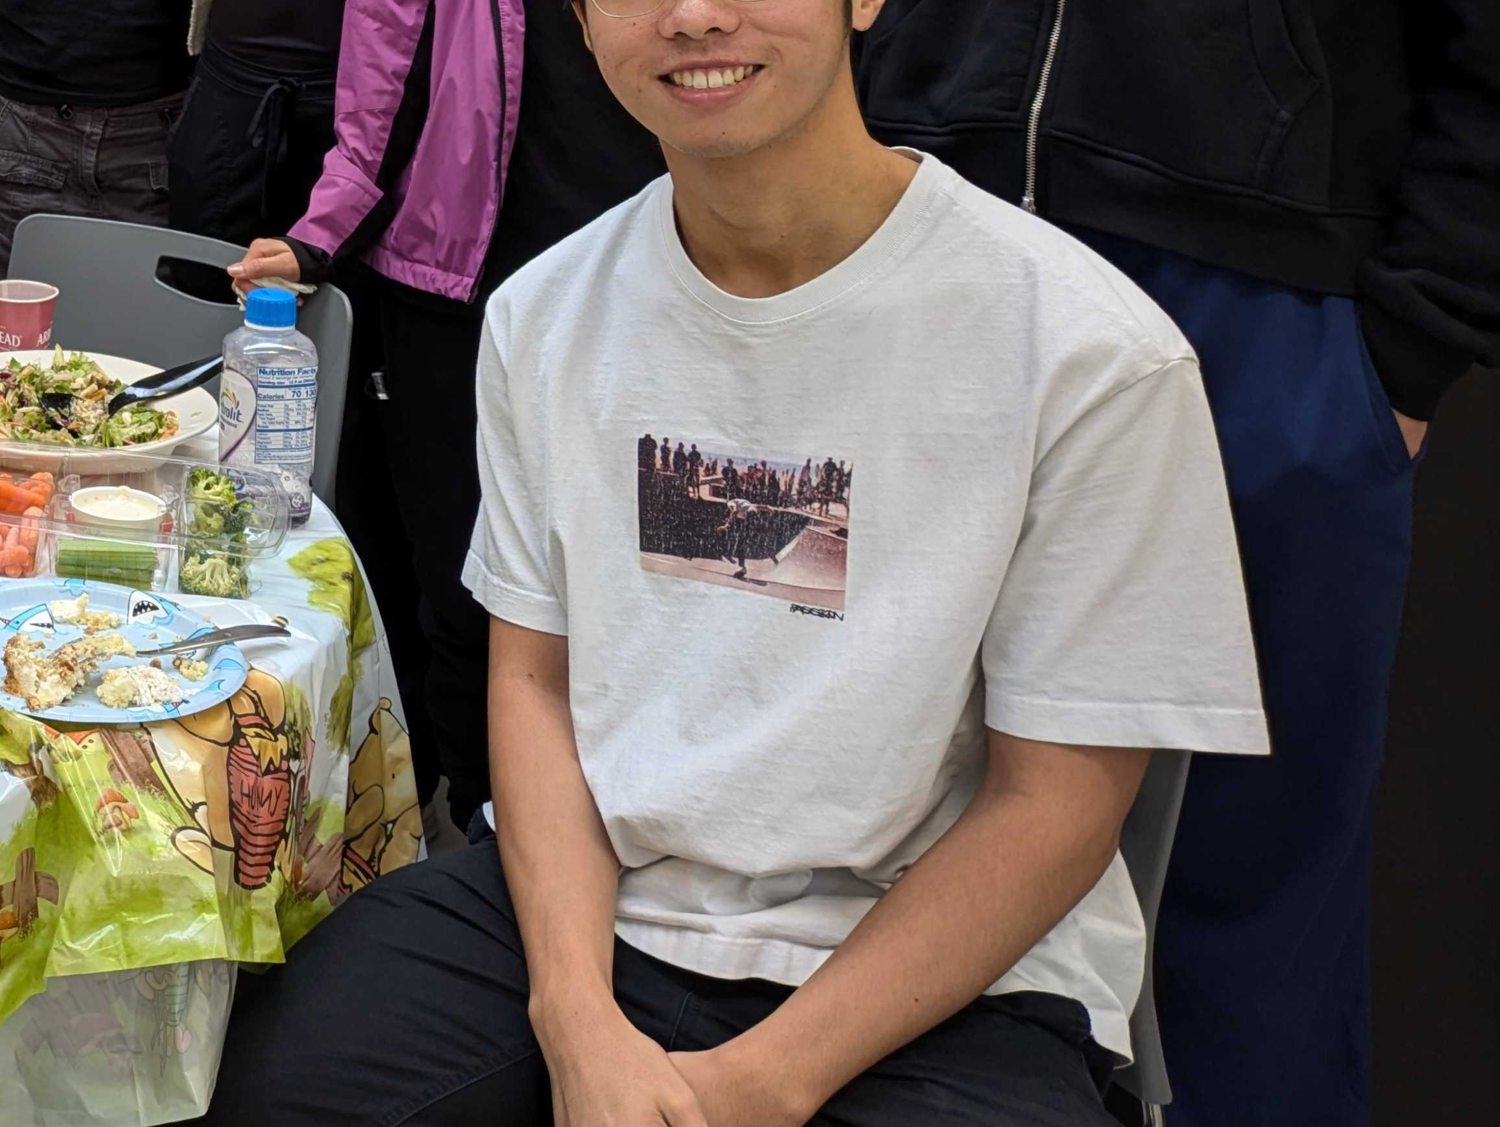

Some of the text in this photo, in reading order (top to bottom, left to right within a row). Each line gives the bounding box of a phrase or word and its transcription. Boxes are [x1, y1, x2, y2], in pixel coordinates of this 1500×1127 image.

[258, 367, 317, 376] Nutrition Facts
[291, 390, 302, 398] 70
